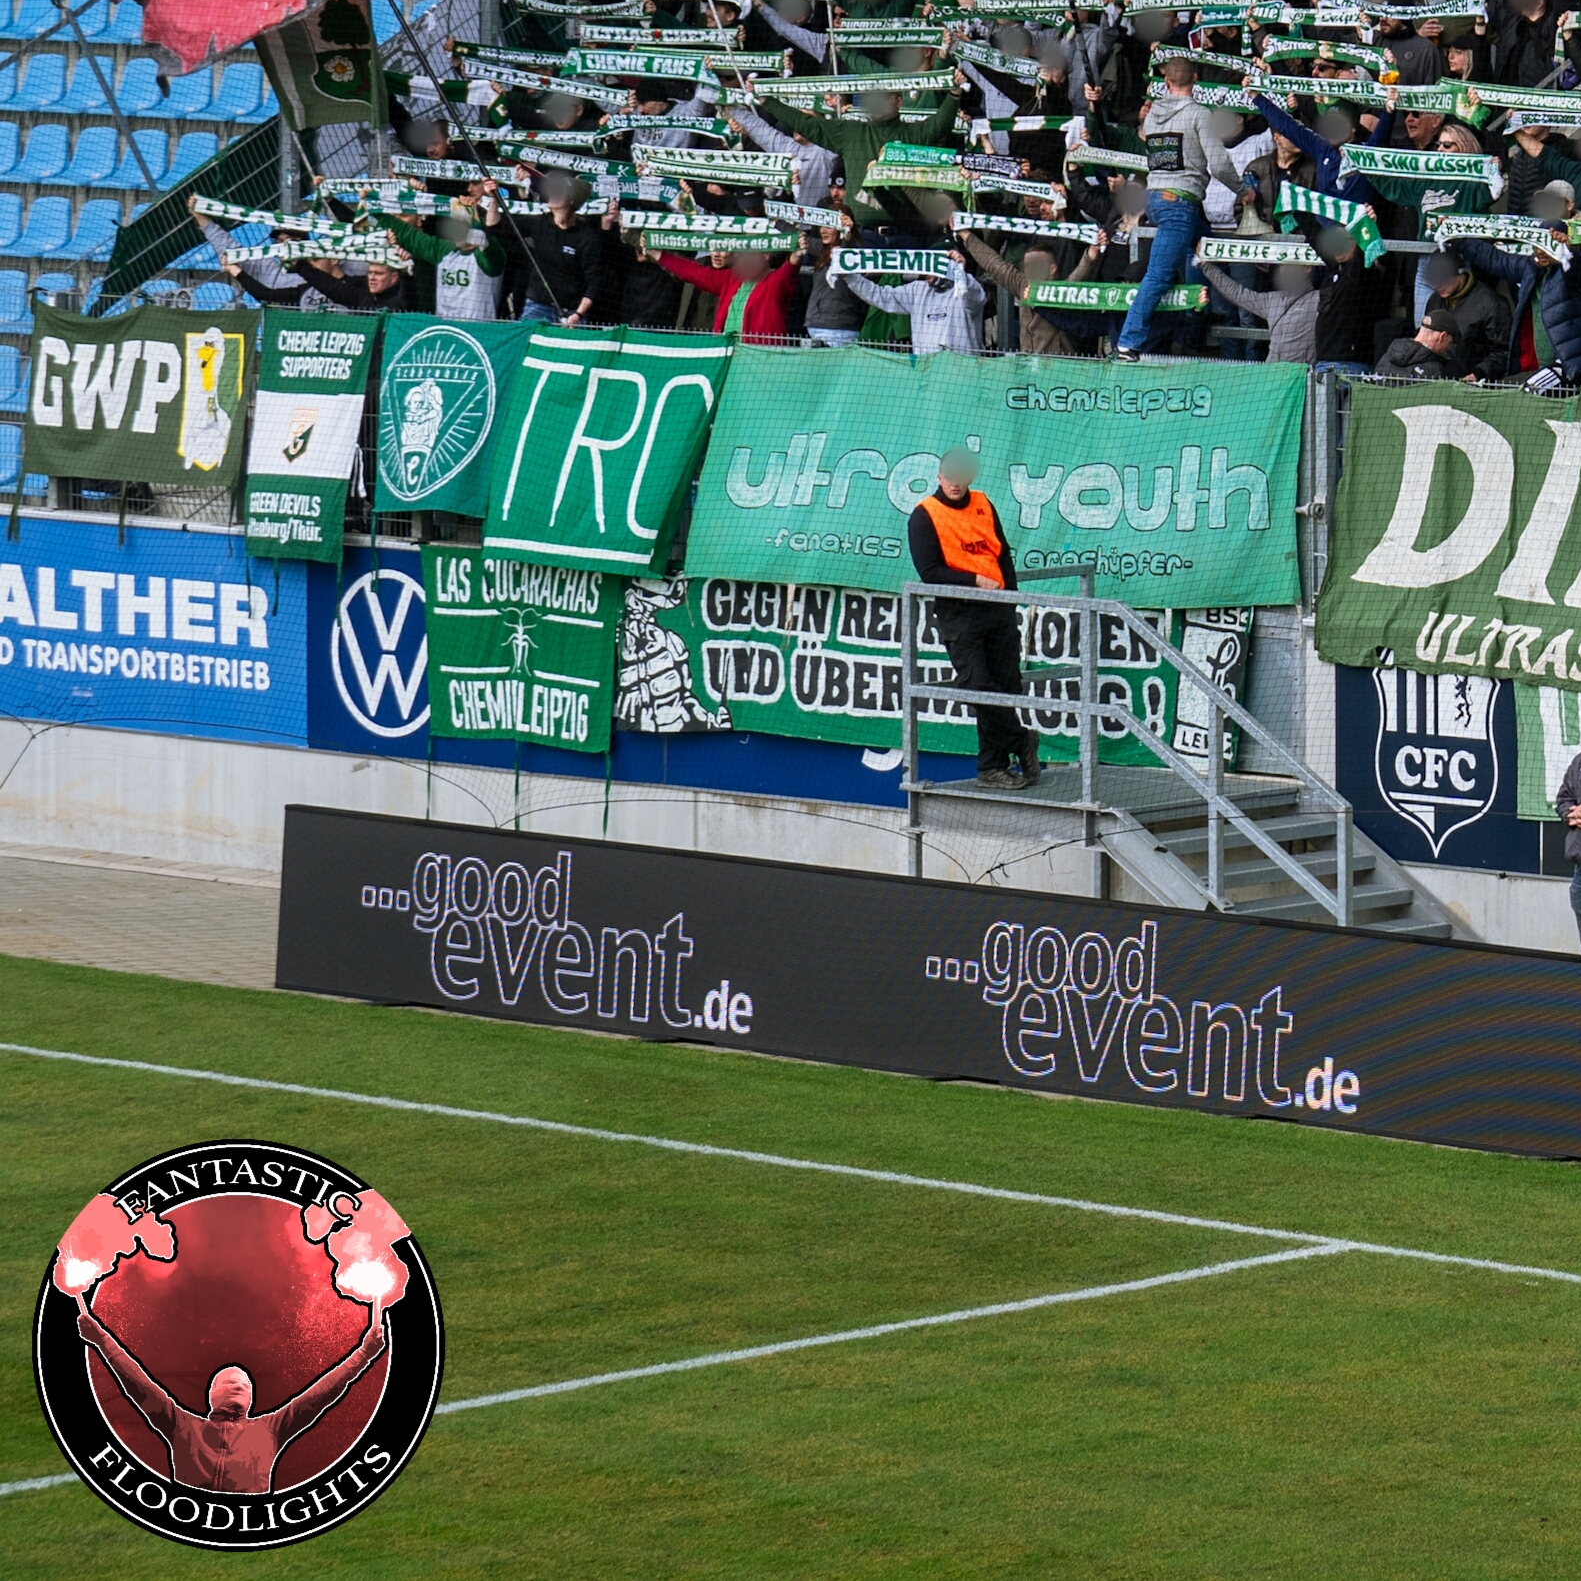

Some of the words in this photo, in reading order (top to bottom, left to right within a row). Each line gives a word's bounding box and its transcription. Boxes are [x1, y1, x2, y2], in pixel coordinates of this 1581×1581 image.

[585, 51, 653, 72] CHEMIE
[655, 55, 698, 77] FANS
[840, 247, 949, 275] CHEMIE
[1036, 285, 1099, 306] ULTRAS
[278, 330, 320, 353] CHEMIE
[321, 332, 365, 356] LEIPZIG
[32, 336, 182, 434] GWP
[280, 356, 353, 381] SUPPORTERS
[436, 556, 471, 604] LAS
[482, 558, 603, 616] CUCARACHAS
[24, 638, 271, 692] TRANSPORTBETRIEB
[703, 640, 785, 704] UND
[1395, 744, 1478, 793] CFC
